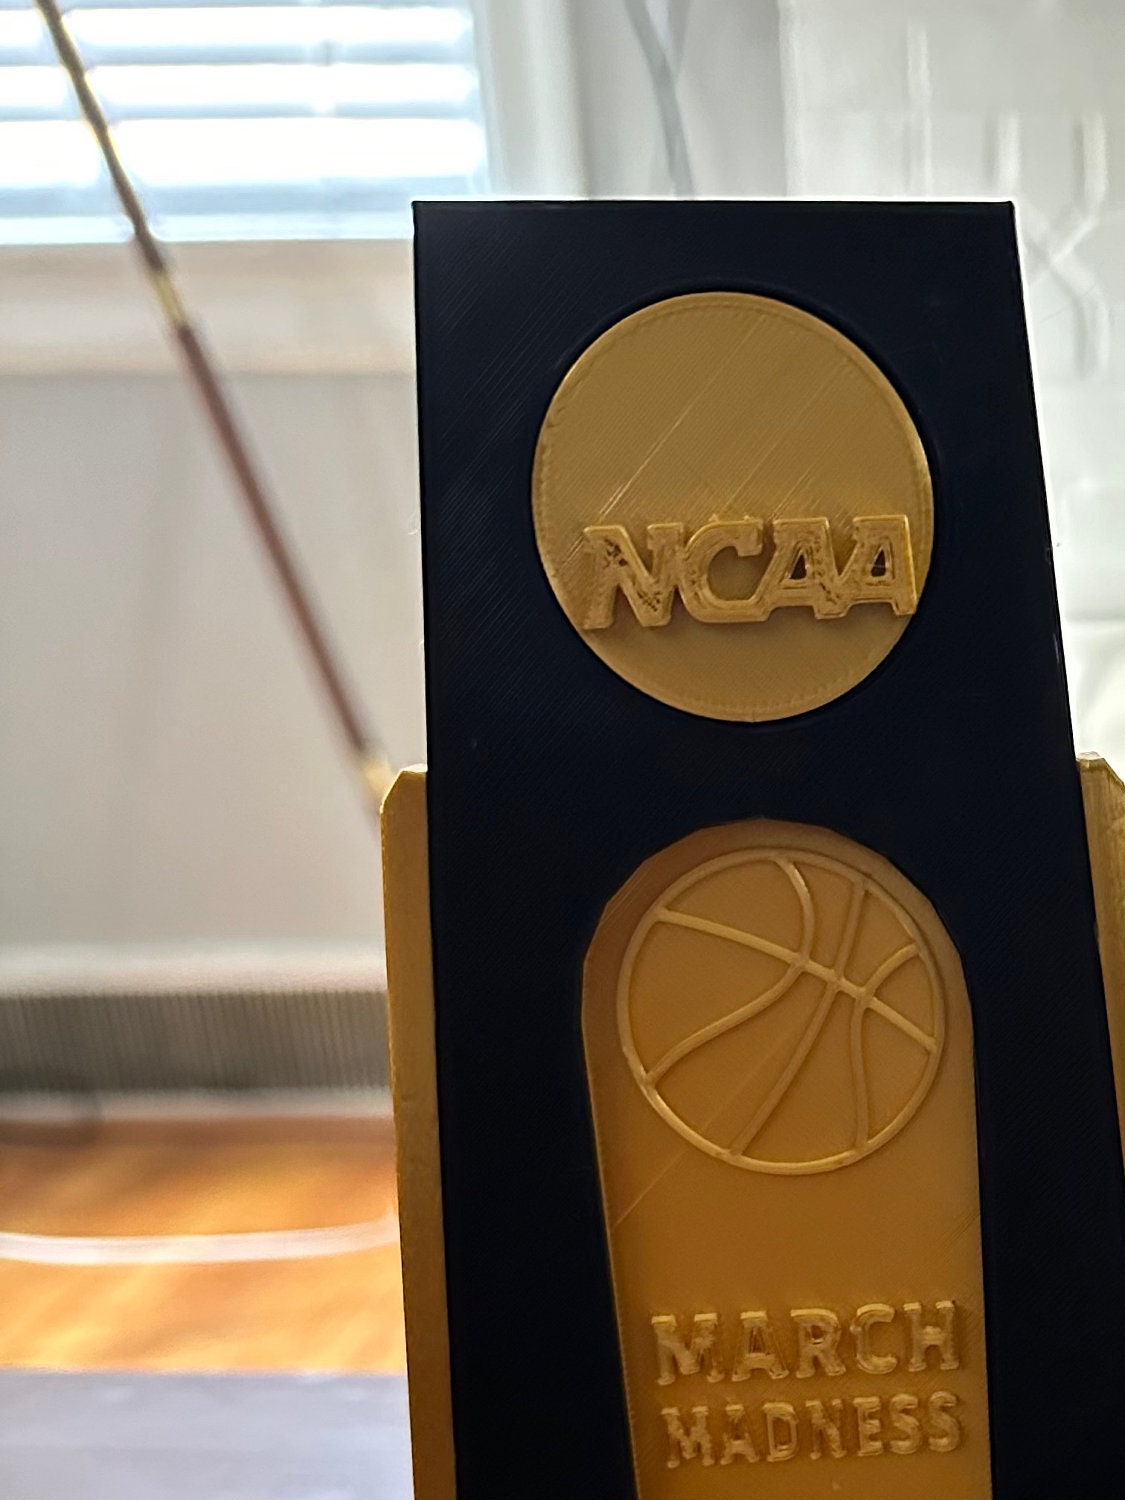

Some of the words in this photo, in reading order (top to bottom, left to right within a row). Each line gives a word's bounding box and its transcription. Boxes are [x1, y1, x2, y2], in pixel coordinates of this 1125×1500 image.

[583, 513, 918, 630] NCAA
[650, 1299, 960, 1386] MARCH
[660, 1390, 962, 1469] MADNESS
